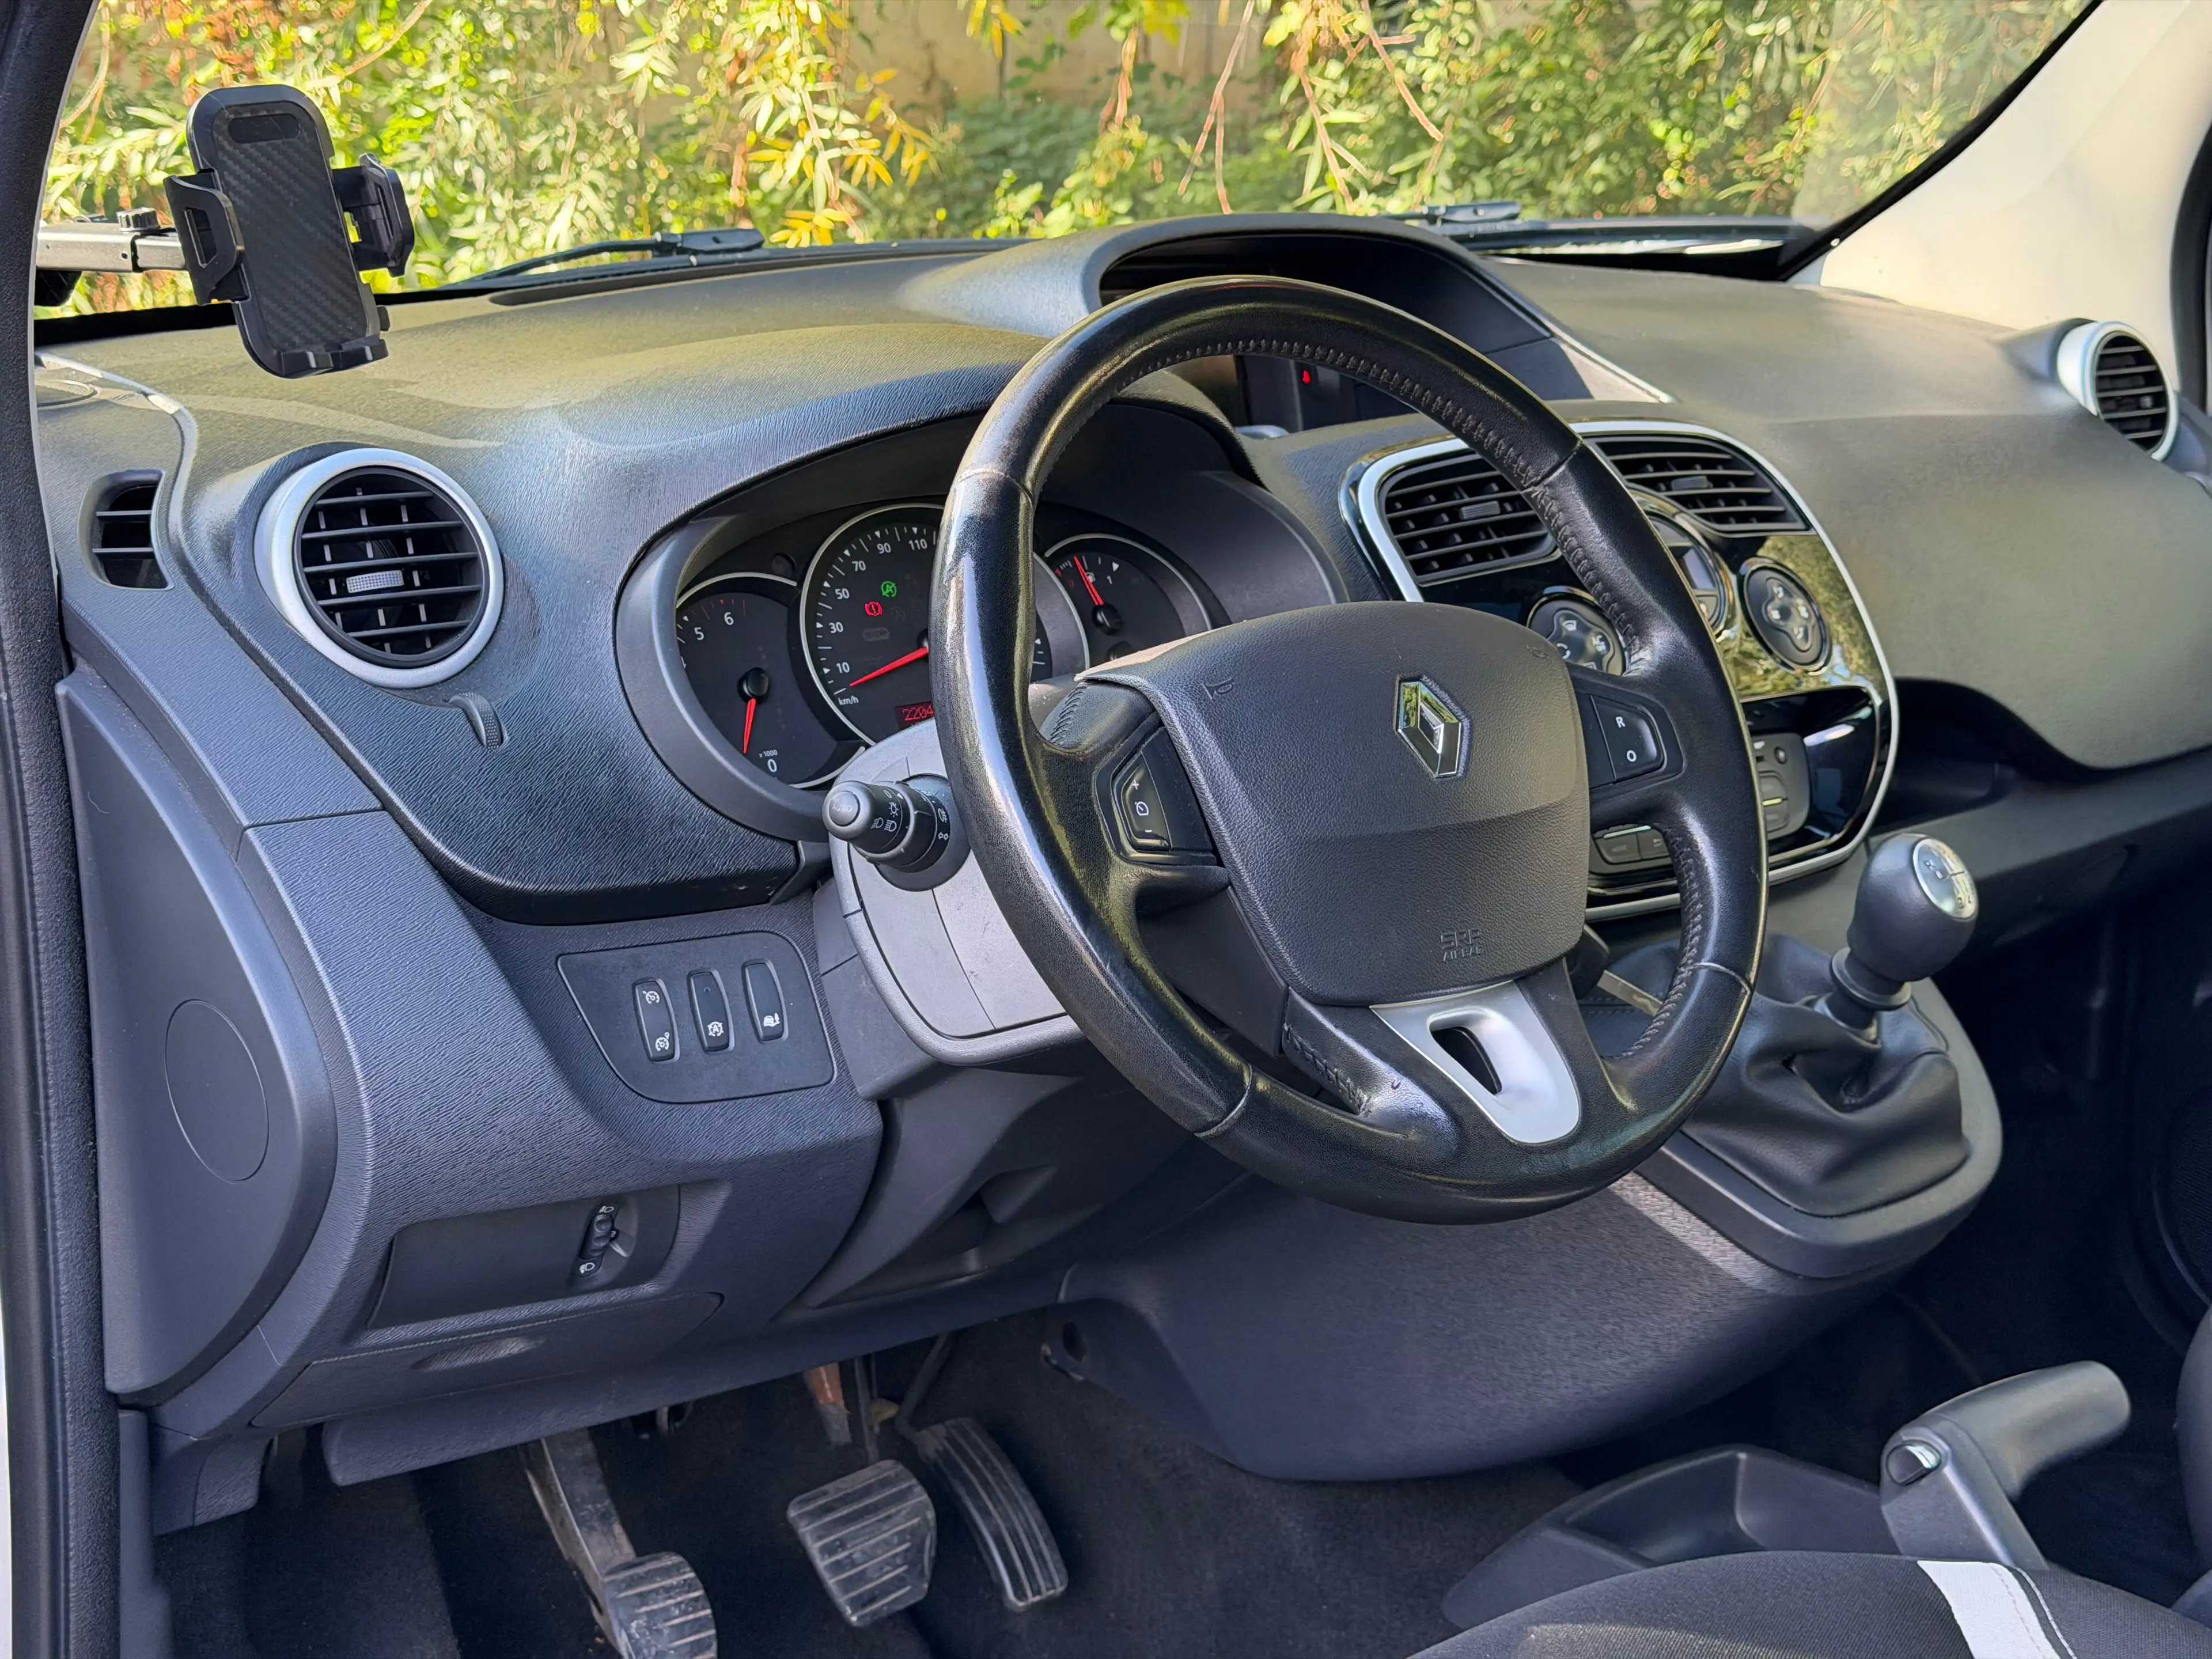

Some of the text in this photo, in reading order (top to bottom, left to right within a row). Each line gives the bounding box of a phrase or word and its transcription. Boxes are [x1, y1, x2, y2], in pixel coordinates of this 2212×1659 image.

[877, 543, 891, 554] 90
[908, 539, 928, 551] 110
[851, 560, 866, 572] 70
[835, 588, 850, 600] 50
[724, 612, 734, 626] 6
[694, 627, 704, 641] 5
[828, 622, 844, 634] 30
[836, 662, 850, 674] 10
[838, 695, 859, 706] km/h
[1615, 716, 1626, 728] R
[763, 749, 778, 757] 1000
[767, 759, 777, 772] 0
[831, 804, 853, 813] AUTO
